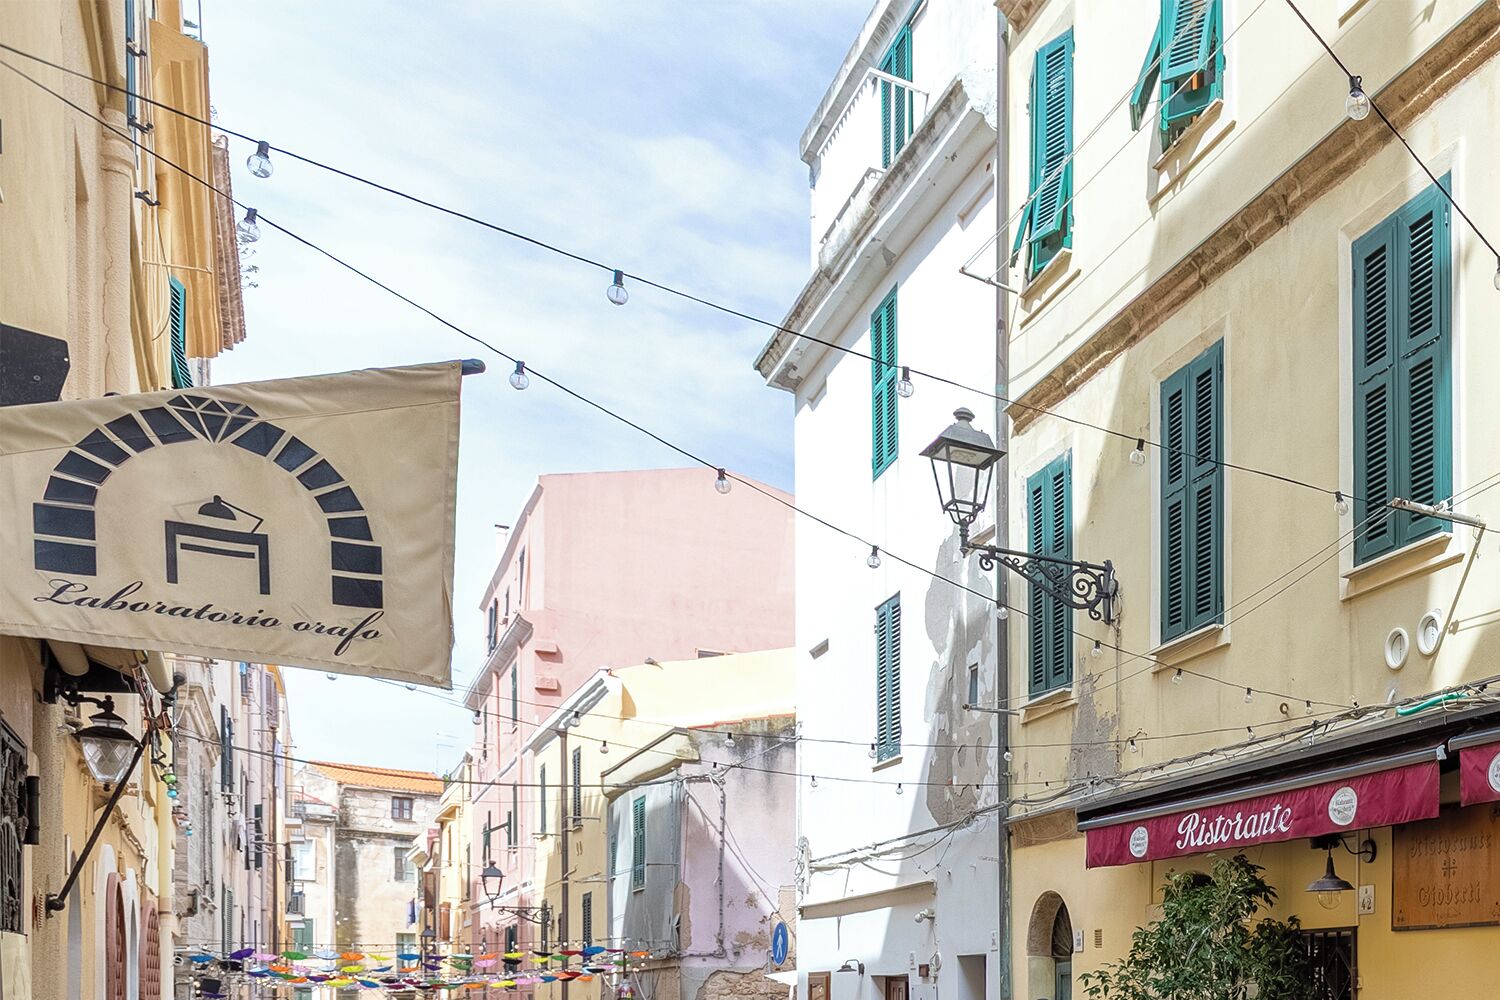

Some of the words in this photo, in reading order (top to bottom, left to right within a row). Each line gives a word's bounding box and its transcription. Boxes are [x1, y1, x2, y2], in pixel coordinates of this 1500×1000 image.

[33, 578, 282, 628] Laboratorio
[292, 610, 385, 657] orafo
[1175, 803, 1294, 850] Ristorante
